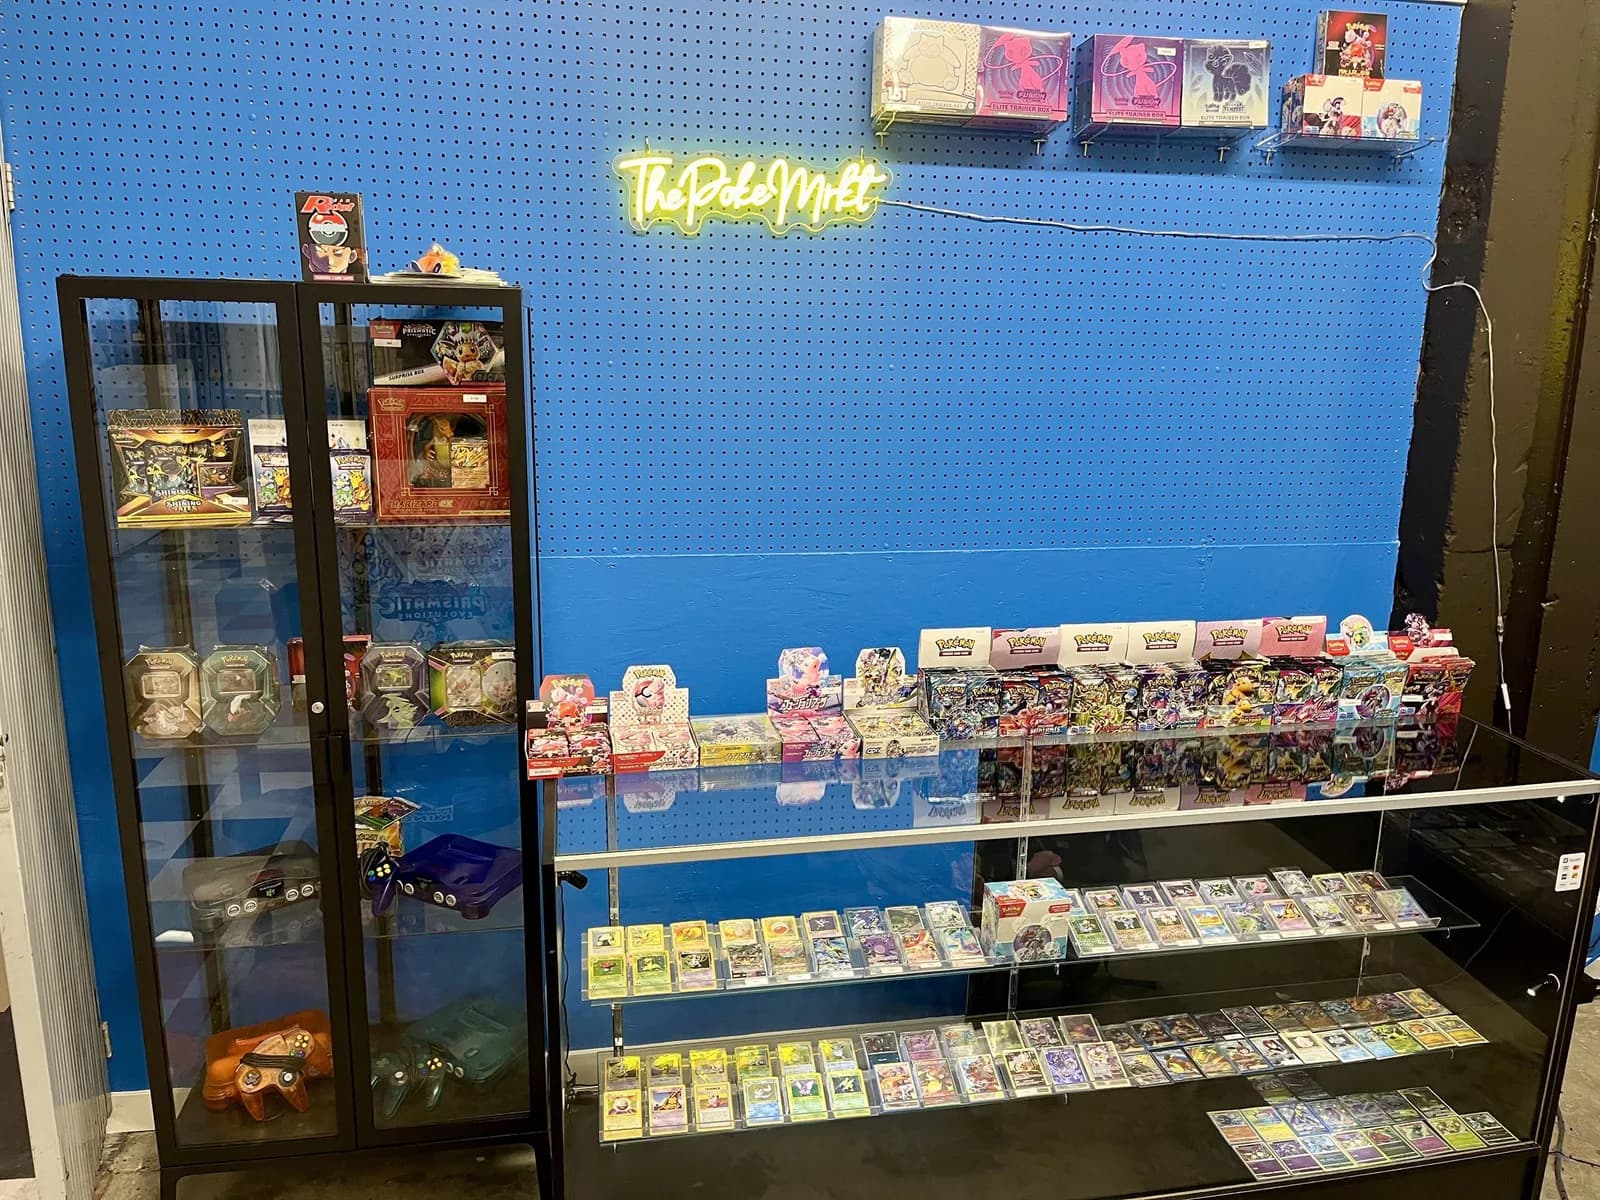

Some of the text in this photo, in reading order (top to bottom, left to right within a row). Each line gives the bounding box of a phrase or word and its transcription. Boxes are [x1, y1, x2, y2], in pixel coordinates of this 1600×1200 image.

[166, 500, 202, 508] SHINING
[1143, 629, 1182, 644] Pokémon
[1210, 626, 1248, 640] Pokémon
[1275, 623, 1313, 637] Pokémon
[936, 636, 976, 650] Pokémon
[1007, 634, 1046, 648] Pokémon
[1074, 632, 1114, 646] Pokémon
